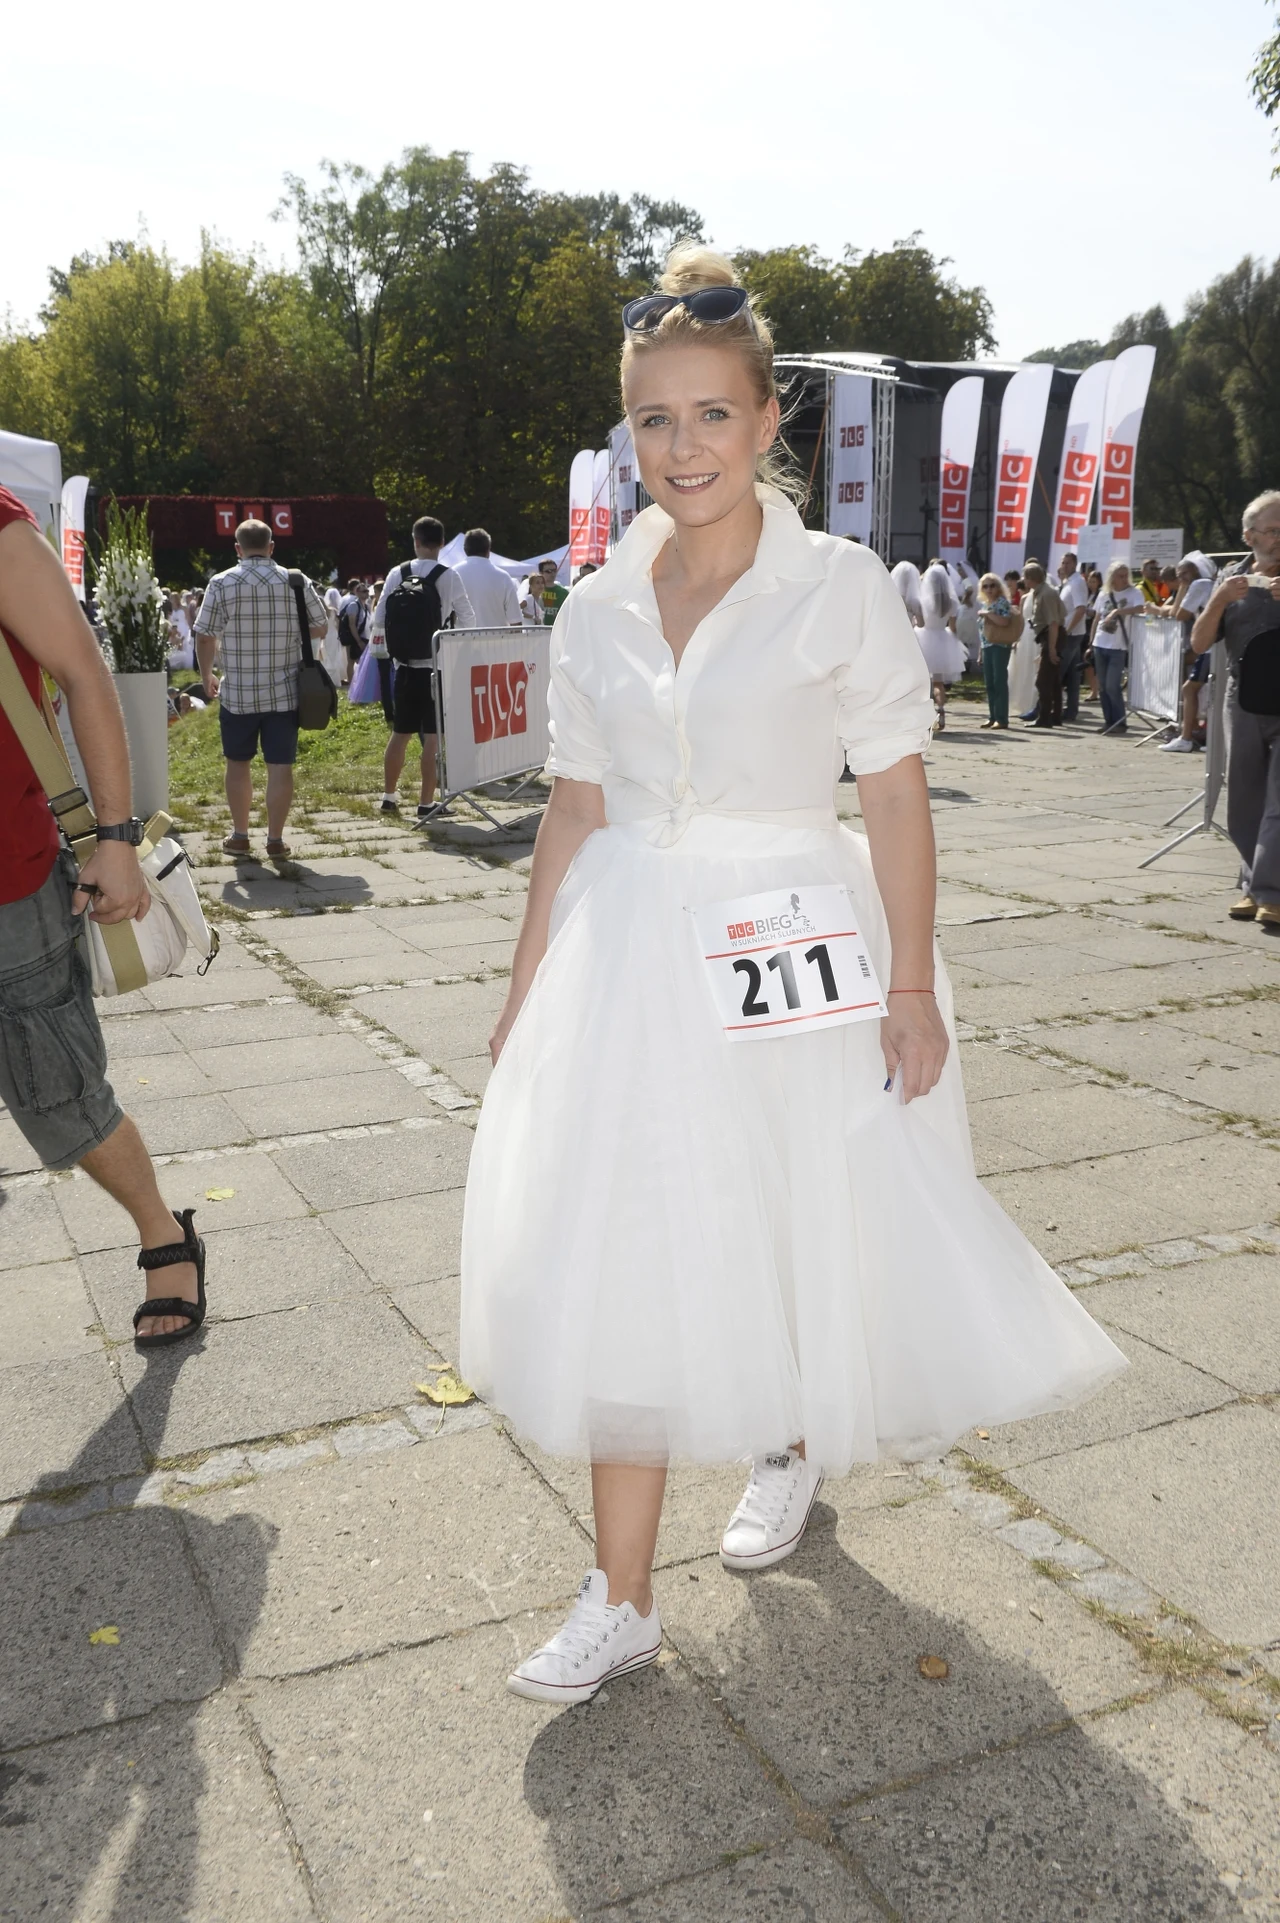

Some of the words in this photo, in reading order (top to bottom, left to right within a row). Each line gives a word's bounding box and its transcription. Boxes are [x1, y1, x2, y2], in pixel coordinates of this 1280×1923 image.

[944, 467, 964, 543] TLC
[1000, 458, 1026, 540] TLC
[1060, 456, 1093, 541] TLC
[473, 675, 527, 730] TLC
[728, 923, 755, 938] TLC
[755, 914, 792, 934] BIEG
[732, 943, 839, 1017] 211
